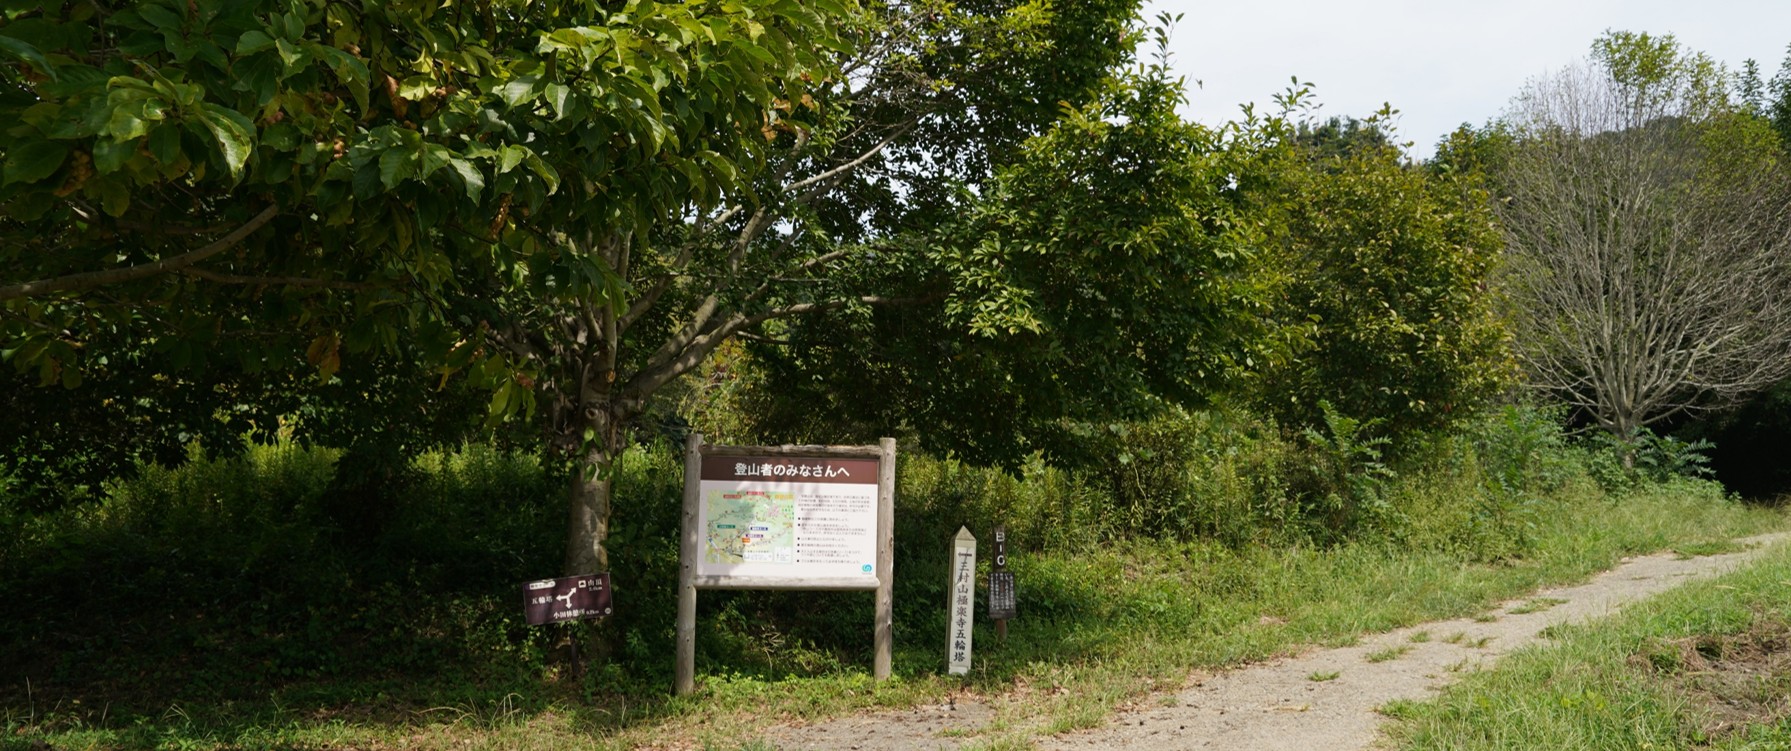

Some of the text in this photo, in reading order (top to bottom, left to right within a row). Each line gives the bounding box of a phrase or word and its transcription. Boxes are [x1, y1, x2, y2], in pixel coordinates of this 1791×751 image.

[734, 462, 850, 478] 登山者のみなさんへ
[953, 561, 970, 663] 三村山極楽寺五輪塔
